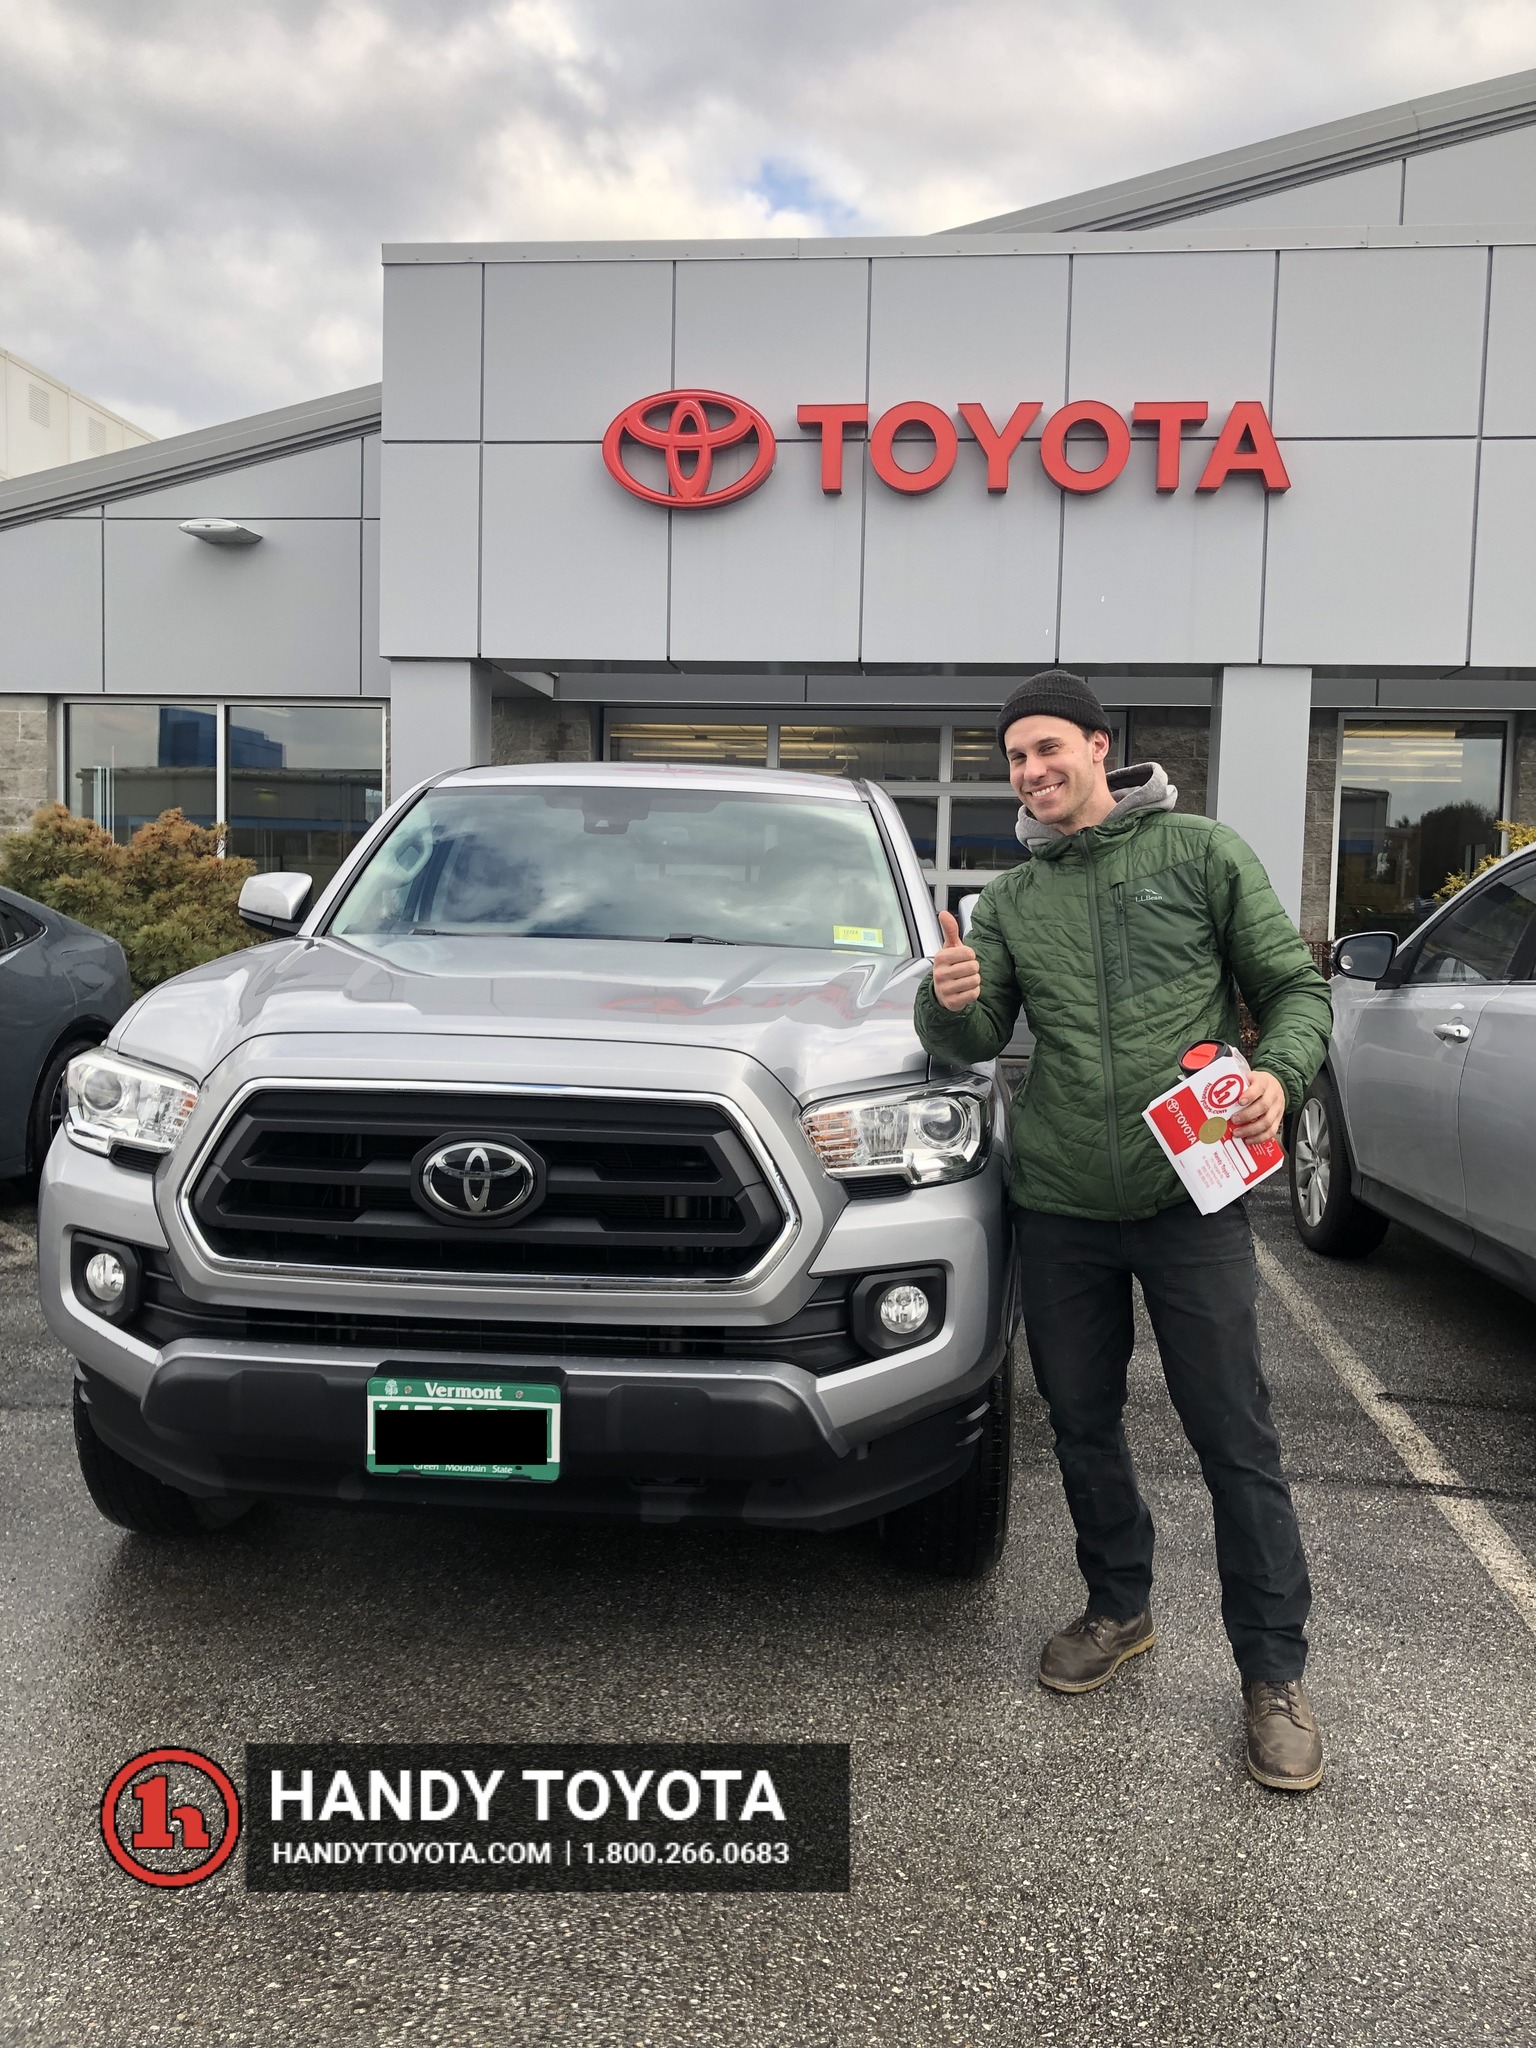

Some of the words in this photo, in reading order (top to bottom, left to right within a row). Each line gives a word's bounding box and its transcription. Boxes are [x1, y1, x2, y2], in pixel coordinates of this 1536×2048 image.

[797, 400, 1291, 495] TOYOTA
[1175, 1109, 1198, 1145] TOYOTA
[424, 1382, 502, 1400] Vermont
[444, 1465, 487, 1473] Mountain
[491, 1465, 513, 1474] State
